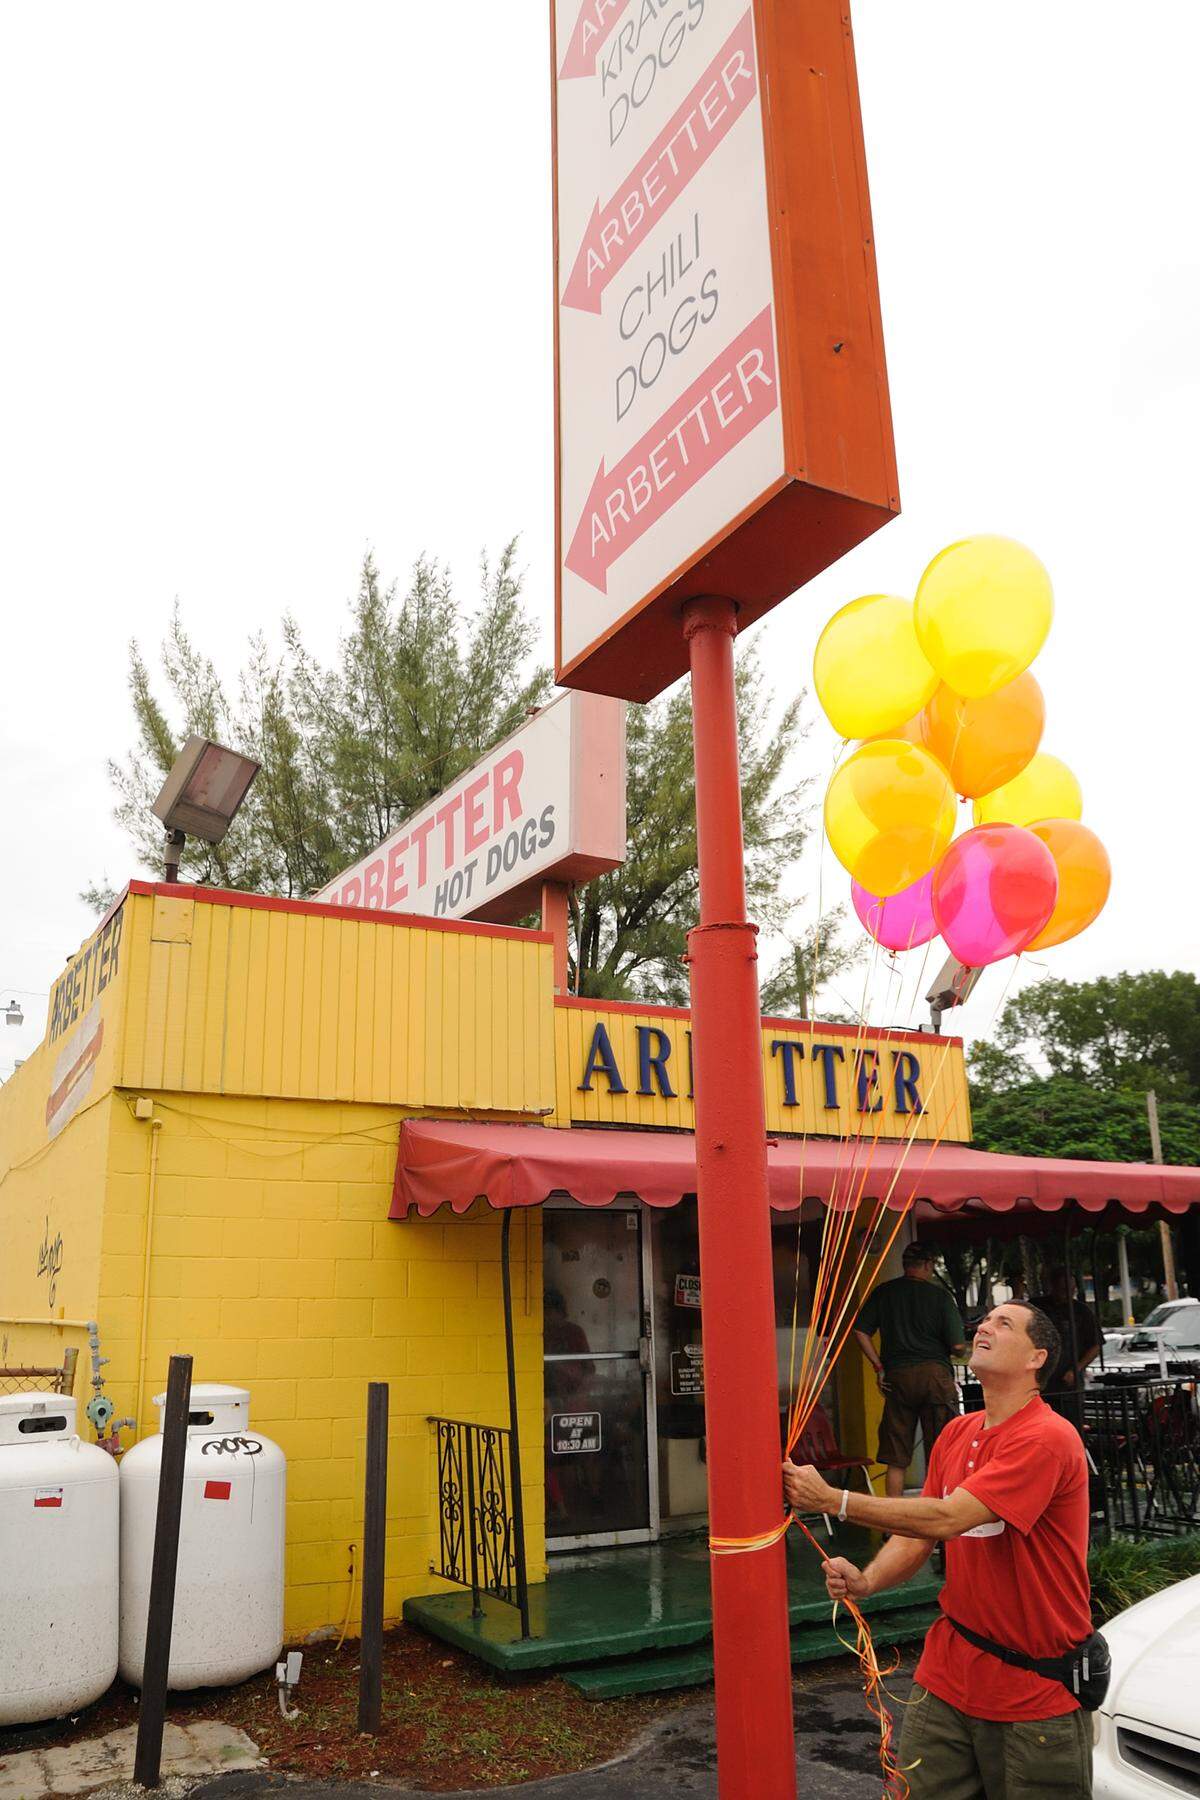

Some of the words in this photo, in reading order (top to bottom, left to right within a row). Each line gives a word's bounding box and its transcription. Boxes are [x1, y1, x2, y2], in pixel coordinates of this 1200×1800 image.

[602, 0, 668, 97] KRA
[584, 50, 752, 287] ARBETTER
[619, 213, 700, 340] CHILI
[616, 269, 718, 423] DOGS
[588, 348, 773, 558] ARBETTER
[330, 749, 524, 908] BETTER
[434, 859, 478, 916] HOT
[486, 805, 555, 886] DOGS
[49, 906, 124, 1048] ARBETTER
[577, 1022, 928, 1115] ARTTER
[679, 1278, 701, 1291] CLOS
[557, 1439, 581, 1450] 10:30
[581, 1438, 596, 1449] AM
[560, 1415, 593, 1427] OPEN
[570, 1427, 584, 1438] AT
